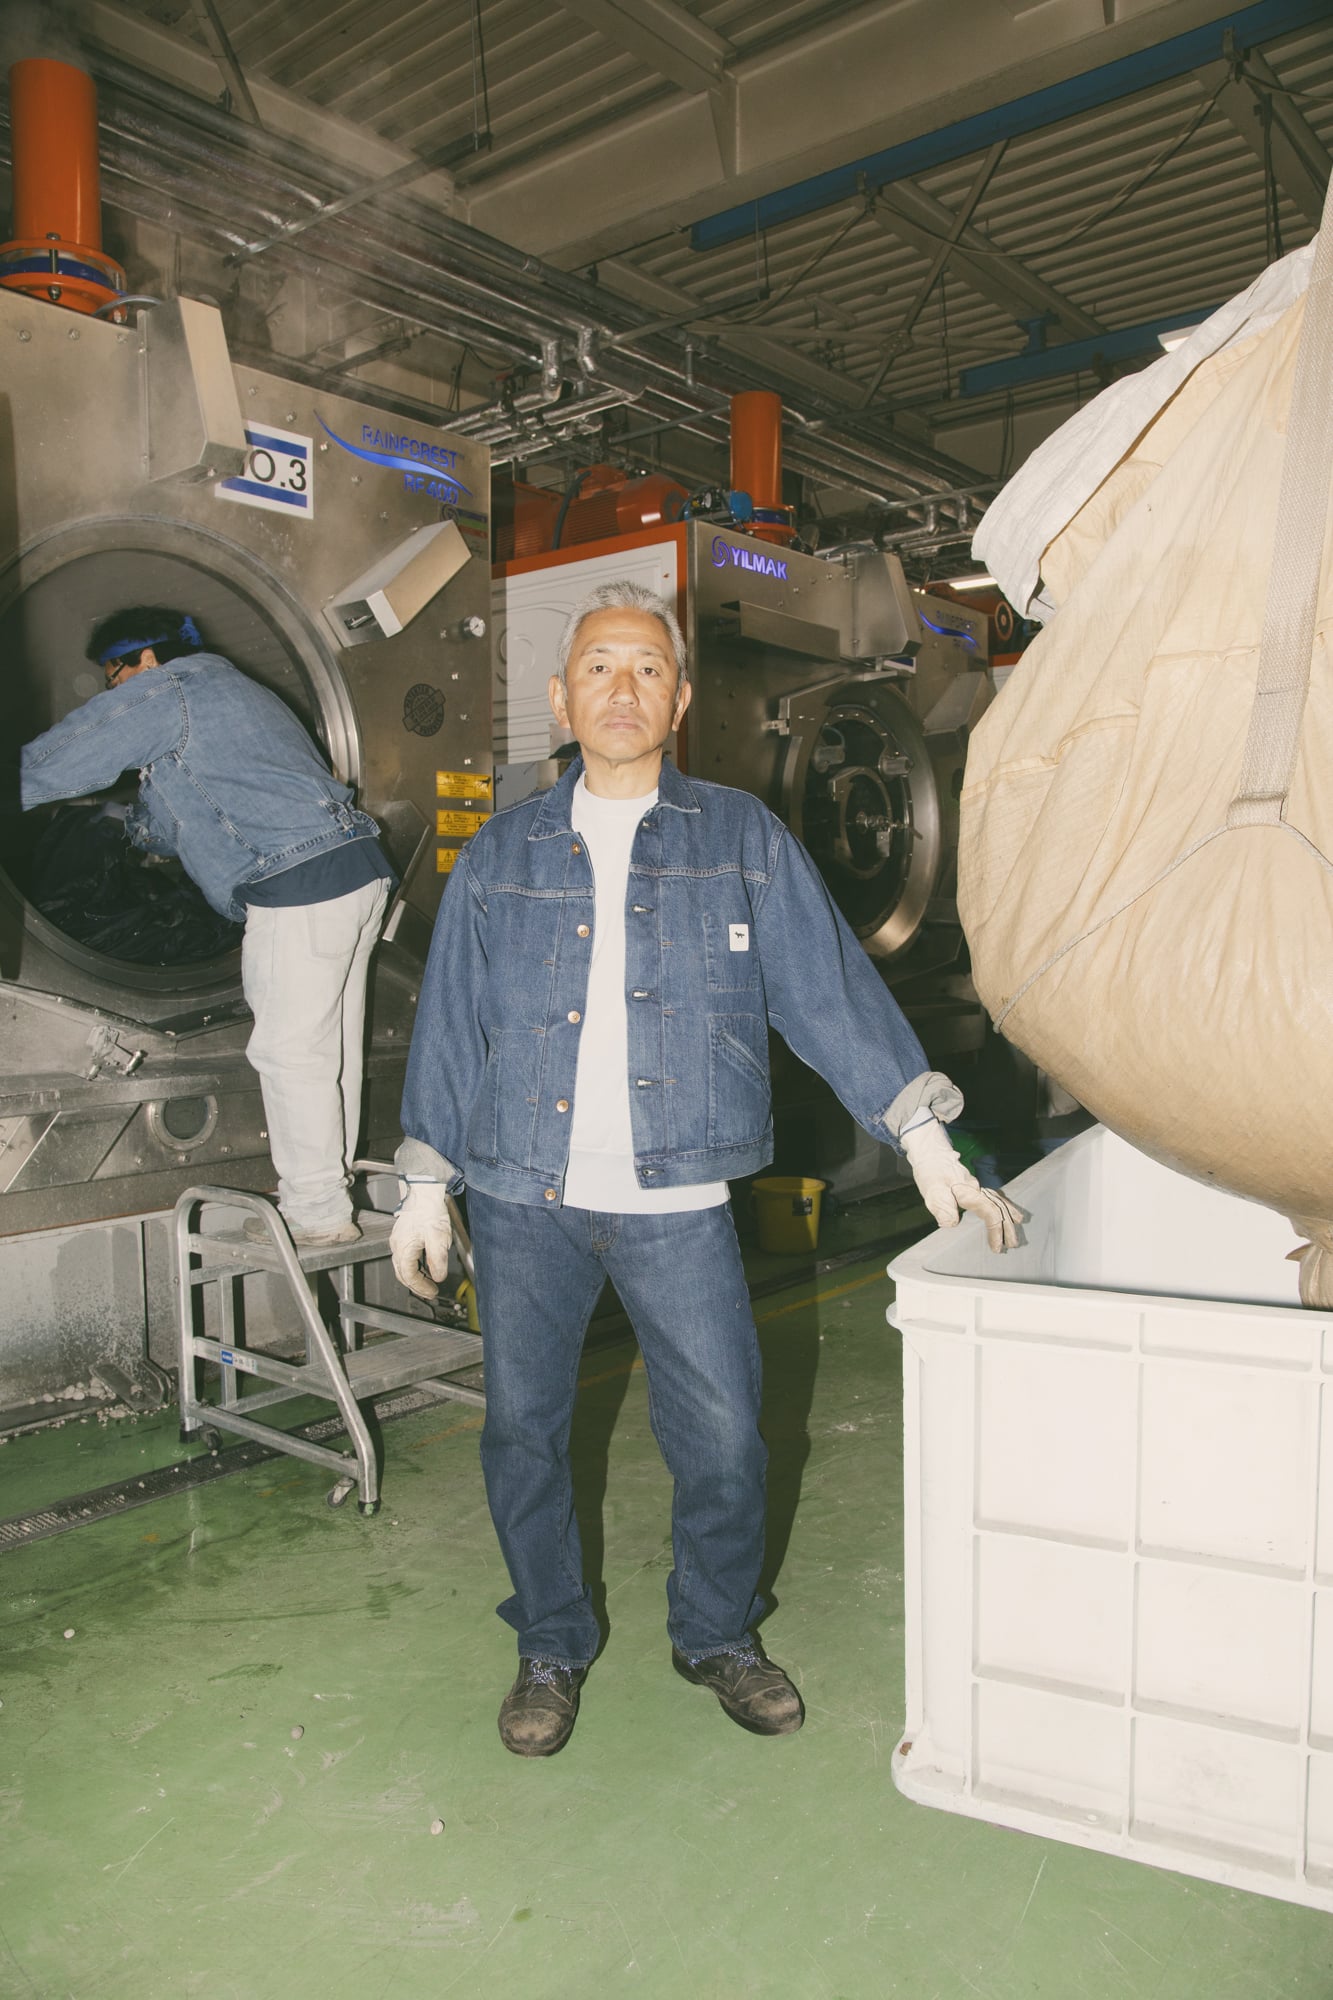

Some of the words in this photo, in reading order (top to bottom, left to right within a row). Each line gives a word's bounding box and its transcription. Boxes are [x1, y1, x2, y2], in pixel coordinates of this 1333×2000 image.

[362, 424, 457, 469] RAINFOREST
[241, 449, 306, 491] O.3
[404, 473, 424, 493] RF
[426, 480, 458, 504] 400
[730, 546, 787, 580] YILMAK
